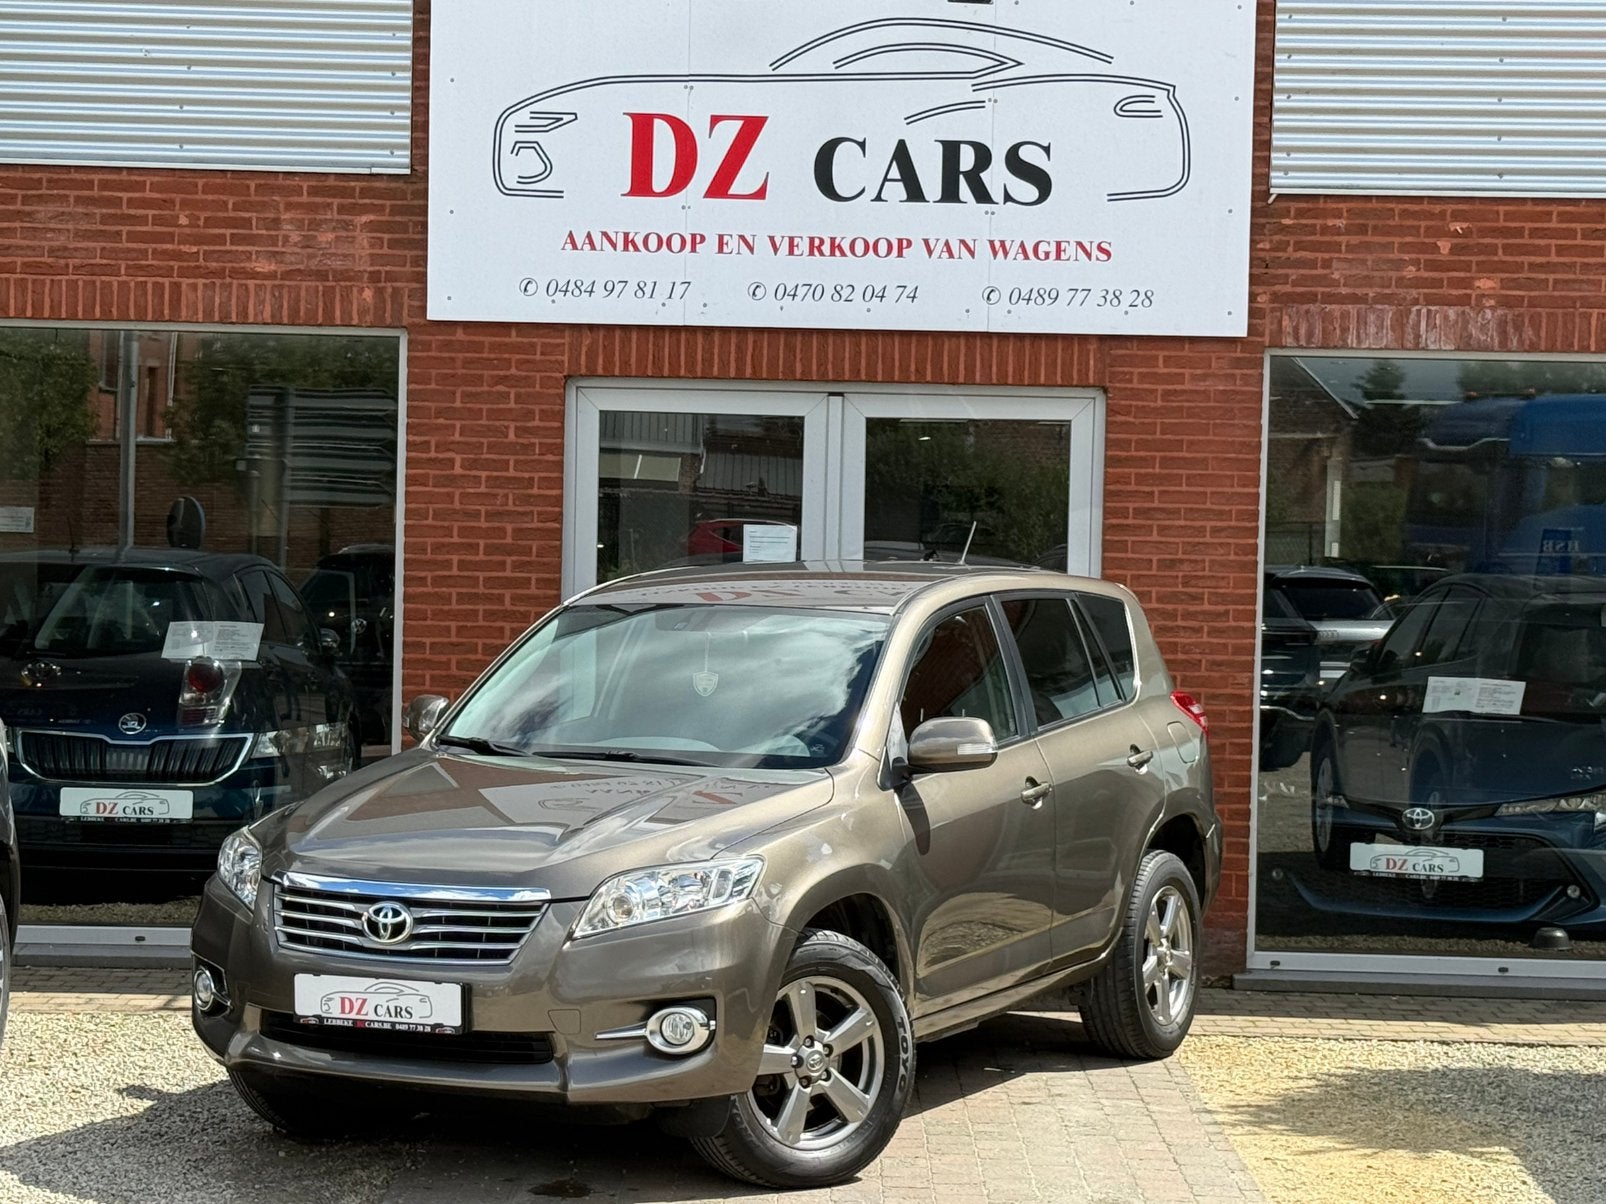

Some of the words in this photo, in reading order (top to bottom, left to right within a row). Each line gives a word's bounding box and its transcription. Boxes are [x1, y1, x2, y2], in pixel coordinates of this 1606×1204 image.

[620, 112, 770, 201] DZ
[813, 136, 1053, 207] CARS
[561, 230, 707, 254] AANKOOP
[715, 233, 757, 256] EN
[767, 235, 913, 258] VERKOOP
[921, 237, 979, 260] VAN
[987, 239, 1112, 262] WAGENS
[545, 278, 597, 298] 0484
[602, 279, 629, 299] 97
[633, 280, 658, 300] 81
[665, 281, 692, 300] 17
[774, 282, 825, 302] 0470
[830, 283, 856, 303] 82
[862, 284, 888, 303] 04
[895, 285, 919, 304] 74
[1008, 286, 1060, 307] 0489
[1065, 288, 1092, 307] 77
[1096, 288, 1123, 308] 38
[1128, 289, 1154, 308] 28
[95, 801, 119, 816] DZ
[122, 805, 154, 816] CARS
[1385, 857, 1409, 872] DZ
[1412, 862, 1444, 874] CARS
[339, 996, 369, 1016] DZ
[374, 1003, 413, 1019] CARS
[897, 1016, 909, 1093] TOYO
